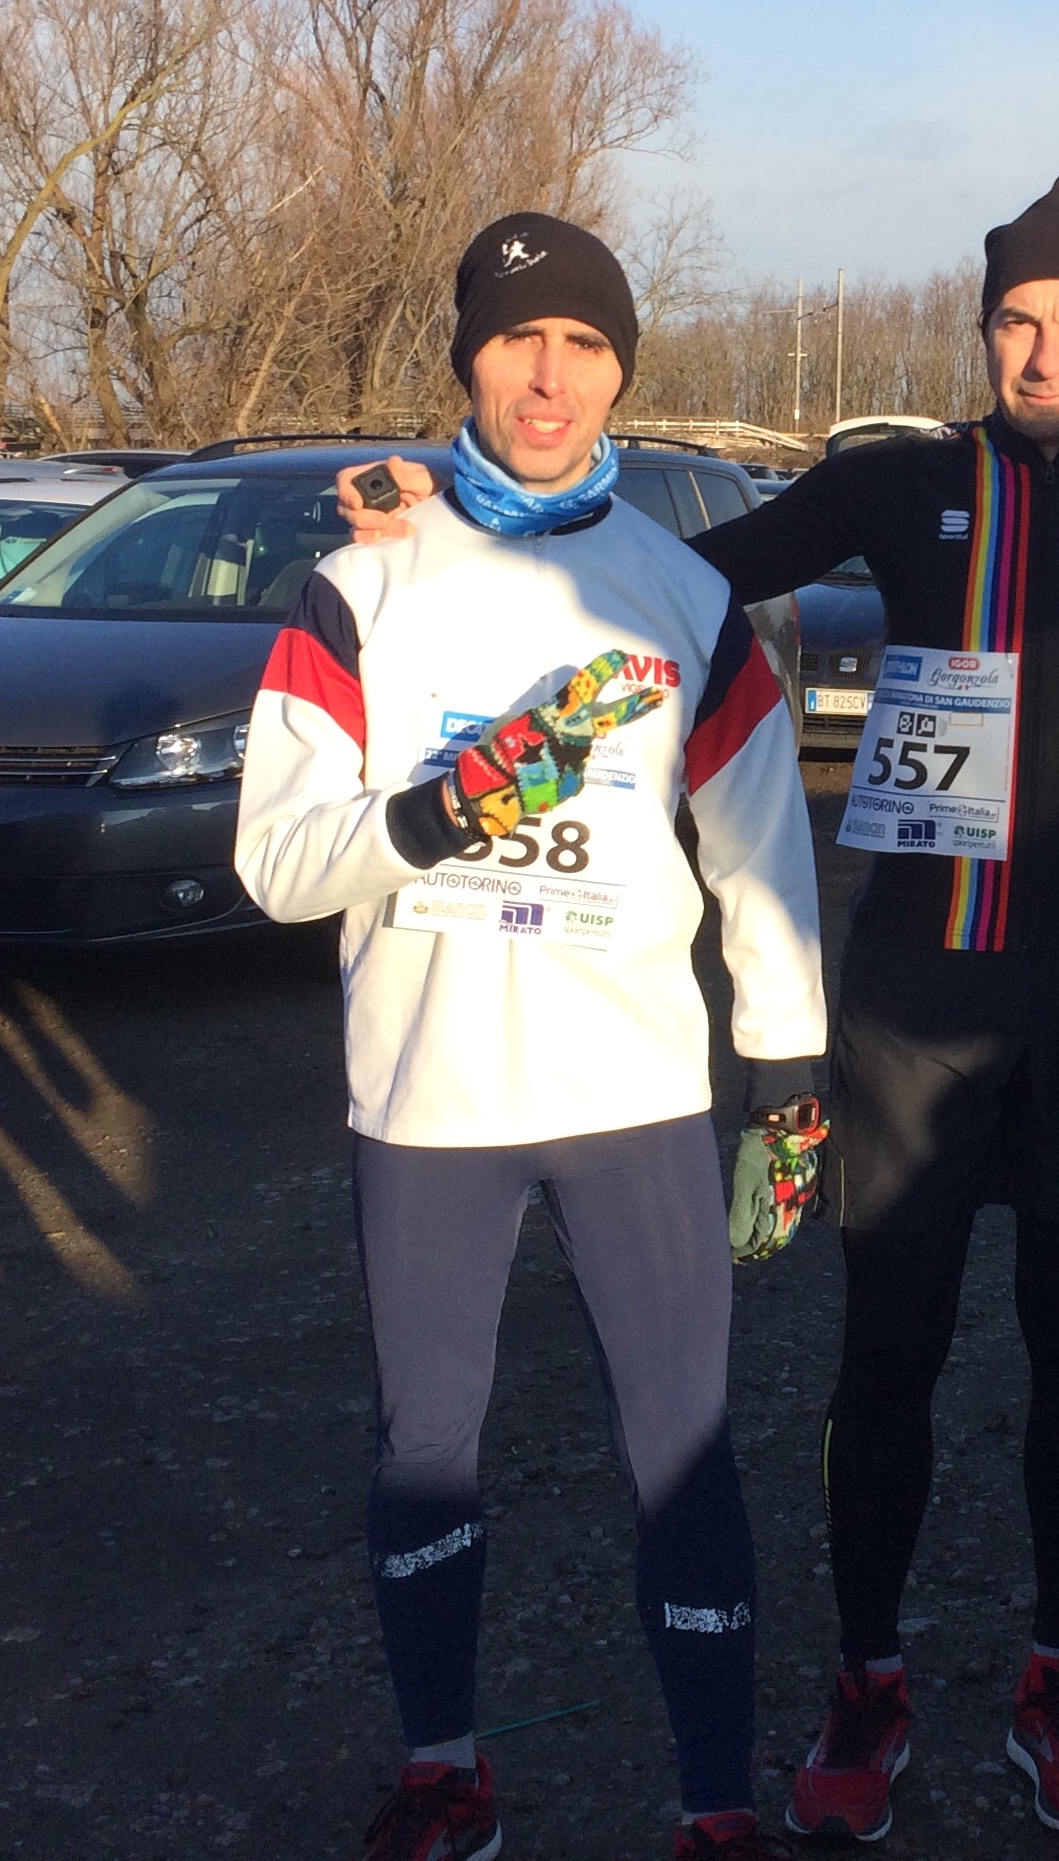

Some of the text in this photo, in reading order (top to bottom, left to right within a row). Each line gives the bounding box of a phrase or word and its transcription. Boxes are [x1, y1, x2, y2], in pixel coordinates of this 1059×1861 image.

[950, 658, 977, 668] IGOR
[927, 667, 999, 690] Gorgonzola
[934, 695, 953, 706] SAN
[954, 697, 1010, 709] GAUDENZIO
[867, 737, 971, 791] 557
[929, 803, 957, 814] Prime
[966, 826, 997, 839] UISP
[896, 839, 936, 849] MIRATO
[539, 885, 570, 897] Prime
[579, 912, 614, 927] UISP
[499, 924, 542, 936] MIRATO
